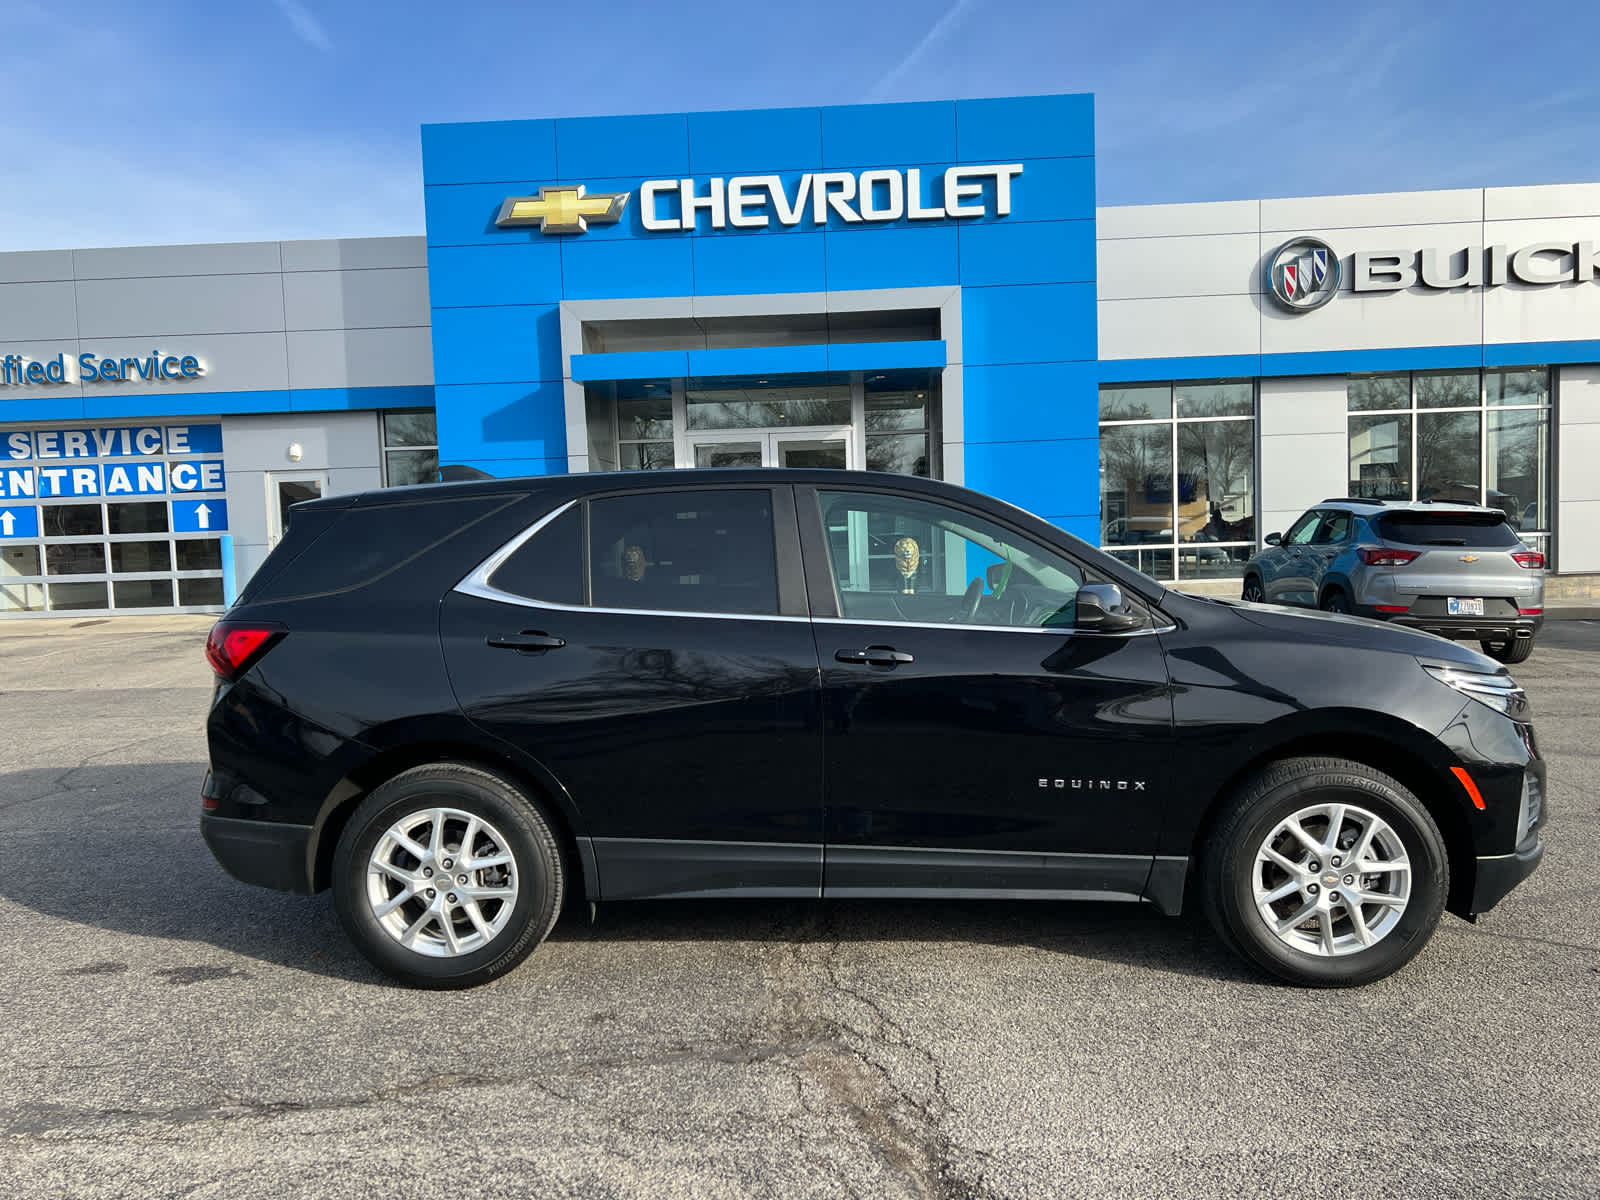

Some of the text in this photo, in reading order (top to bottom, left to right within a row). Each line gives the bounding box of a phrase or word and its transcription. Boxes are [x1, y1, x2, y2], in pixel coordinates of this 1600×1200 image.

[639, 163, 1024, 231] CHEVROLET
[79, 350, 200, 381] Service
[8, 427, 192, 460] SERVICE
[0, 463, 224, 497] NTRANCE
[1038, 778, 1145, 791] EQUINOX
